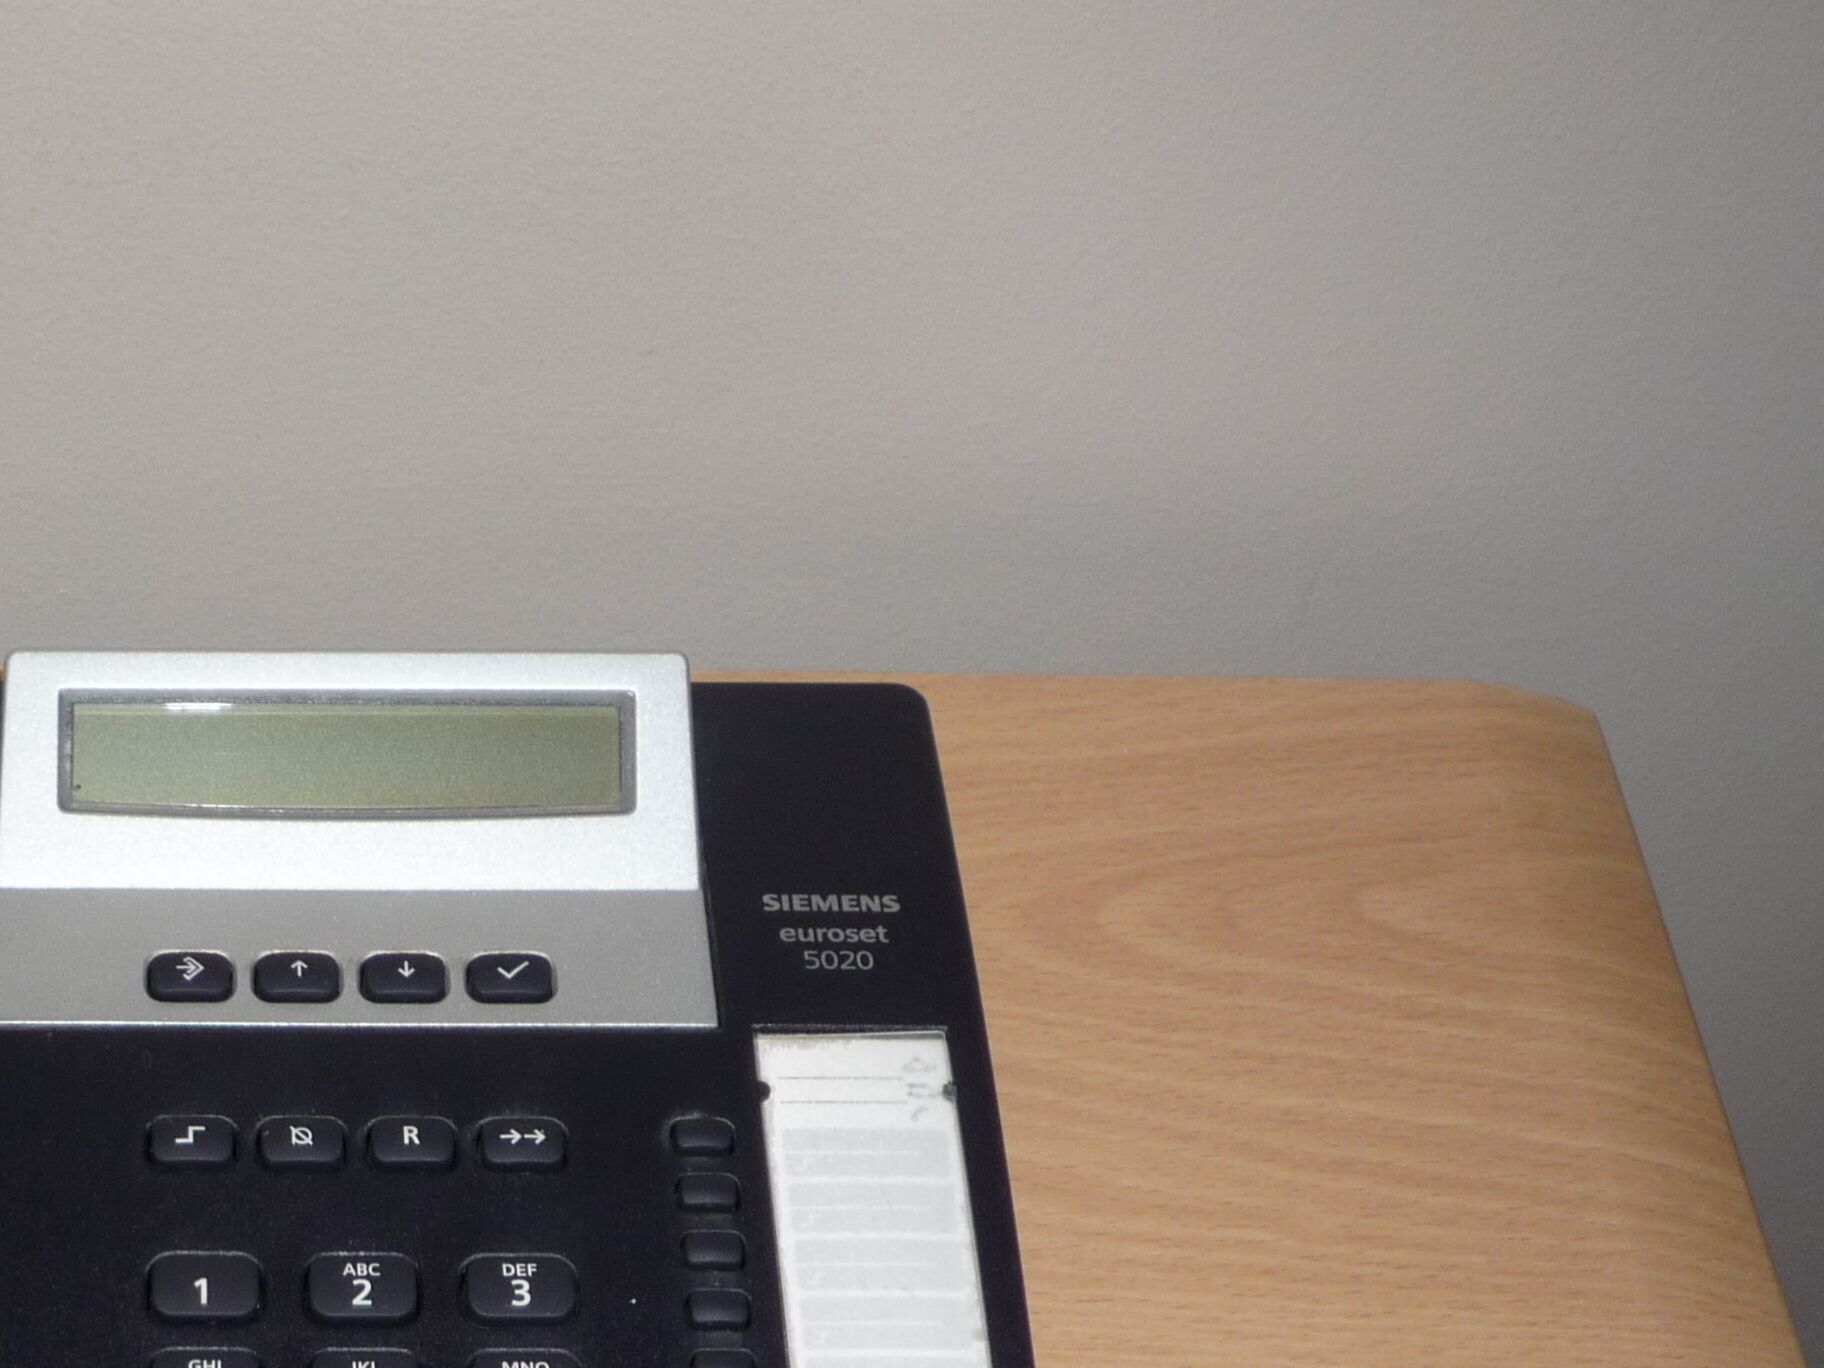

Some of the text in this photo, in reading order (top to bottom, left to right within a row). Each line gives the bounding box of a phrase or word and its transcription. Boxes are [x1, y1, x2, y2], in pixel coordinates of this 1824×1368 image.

[762, 893, 901, 913] SIEMENS
[779, 925, 890, 943] euroset
[803, 950, 874, 970] 5020
[403, 1125, 420, 1145] R
[342, 1262, 381, 1277] ABC
[501, 1263, 537, 1277] DEF
[193, 1277, 208, 1306] 1
[351, 1278, 373, 1306] 2
[511, 1278, 532, 1307] 3
